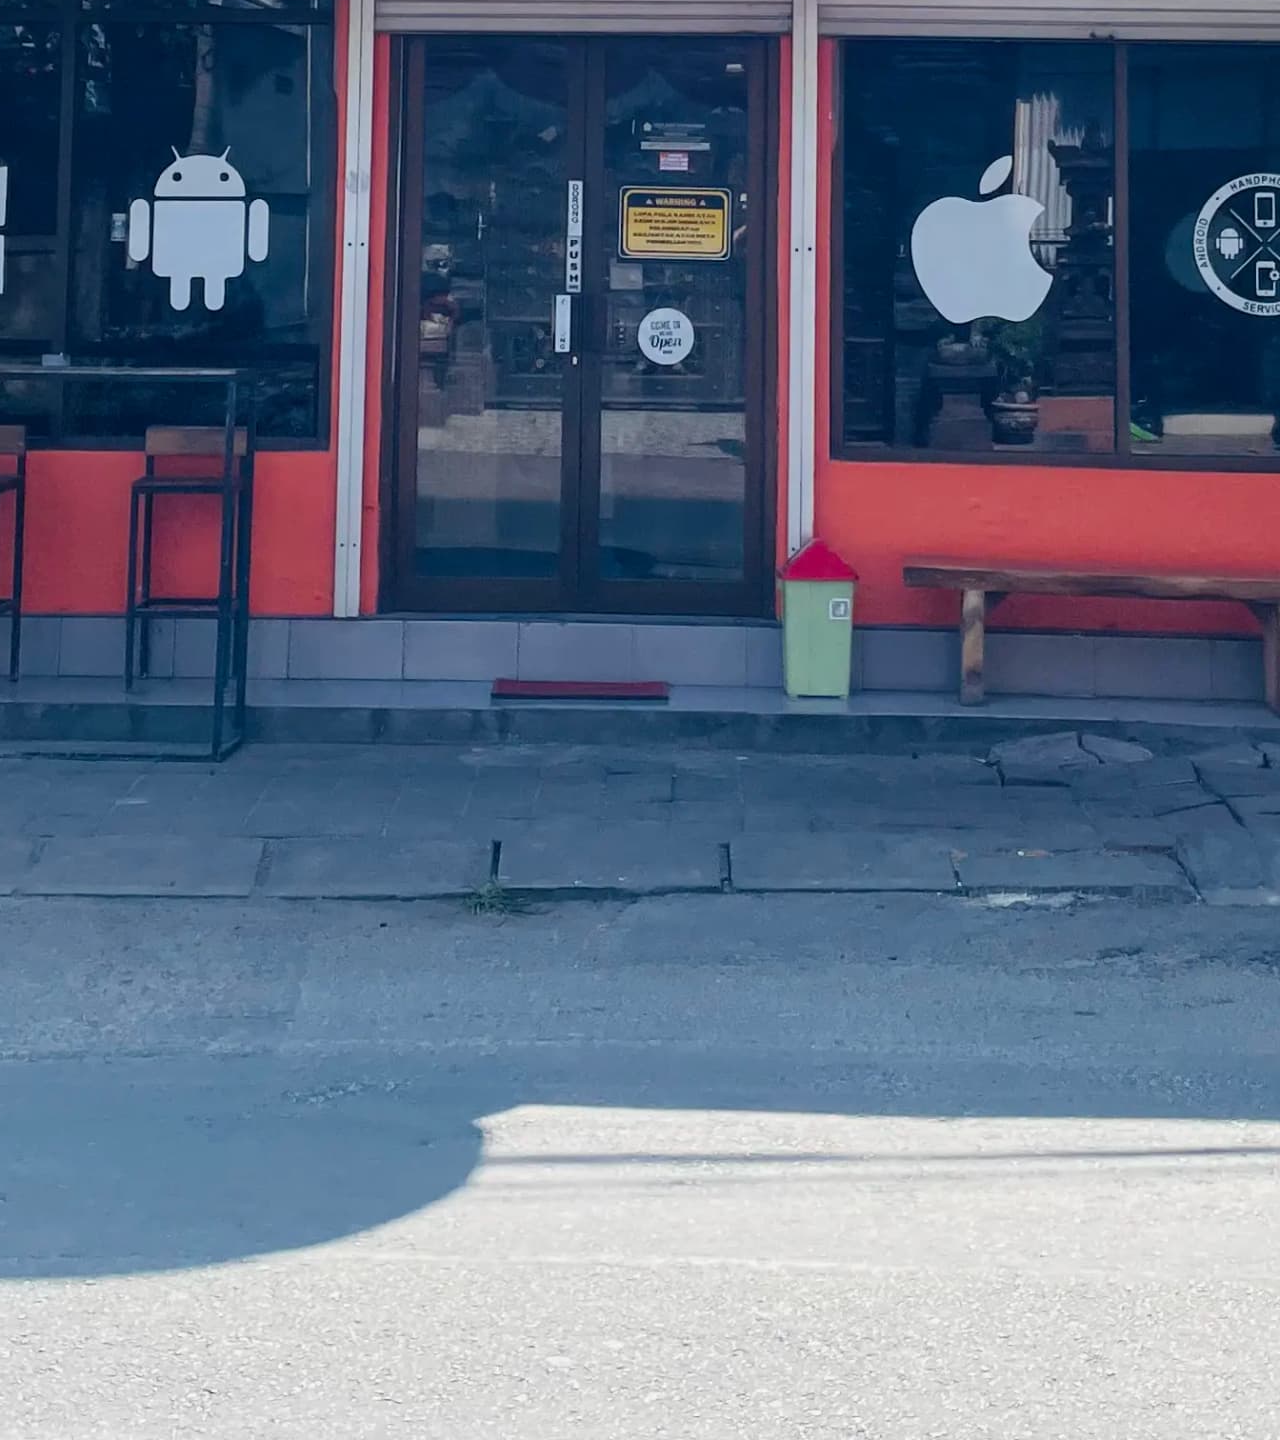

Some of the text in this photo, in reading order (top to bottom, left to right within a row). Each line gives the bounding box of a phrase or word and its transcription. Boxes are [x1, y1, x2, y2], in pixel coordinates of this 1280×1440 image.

[569, 239, 579, 283] PUSH
[1195, 217, 1209, 268] ANDROID
[649, 334, 682, 351] Open
